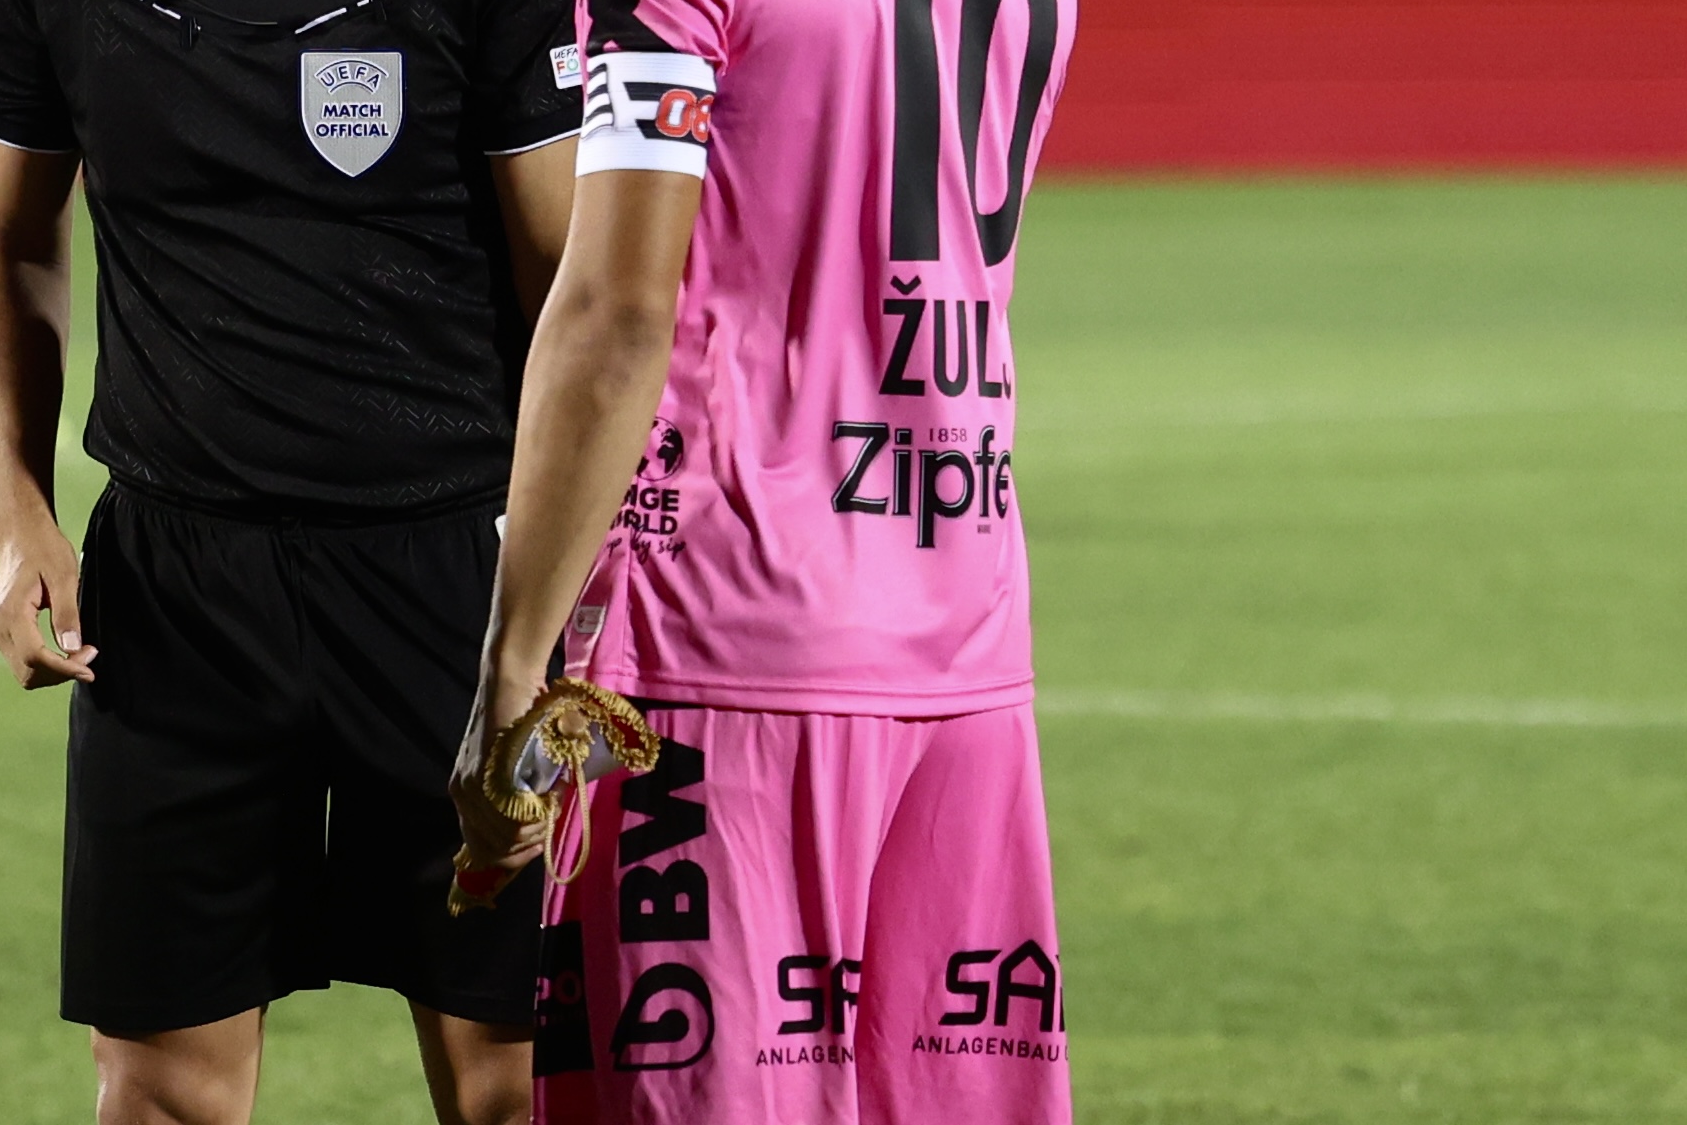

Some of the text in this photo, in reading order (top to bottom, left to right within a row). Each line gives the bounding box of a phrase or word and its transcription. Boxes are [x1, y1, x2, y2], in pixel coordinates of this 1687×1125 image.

[553, 46, 579, 60] UEFA
[320, 65, 380, 88] UEFA
[323, 104, 382, 118] MATCH
[315, 123, 389, 137] OFFICIAL
[928, 428, 967, 443] 1858
[938, 939, 1066, 1034] SA
[912, 1035, 1060, 1063] ANLAGENBAU
